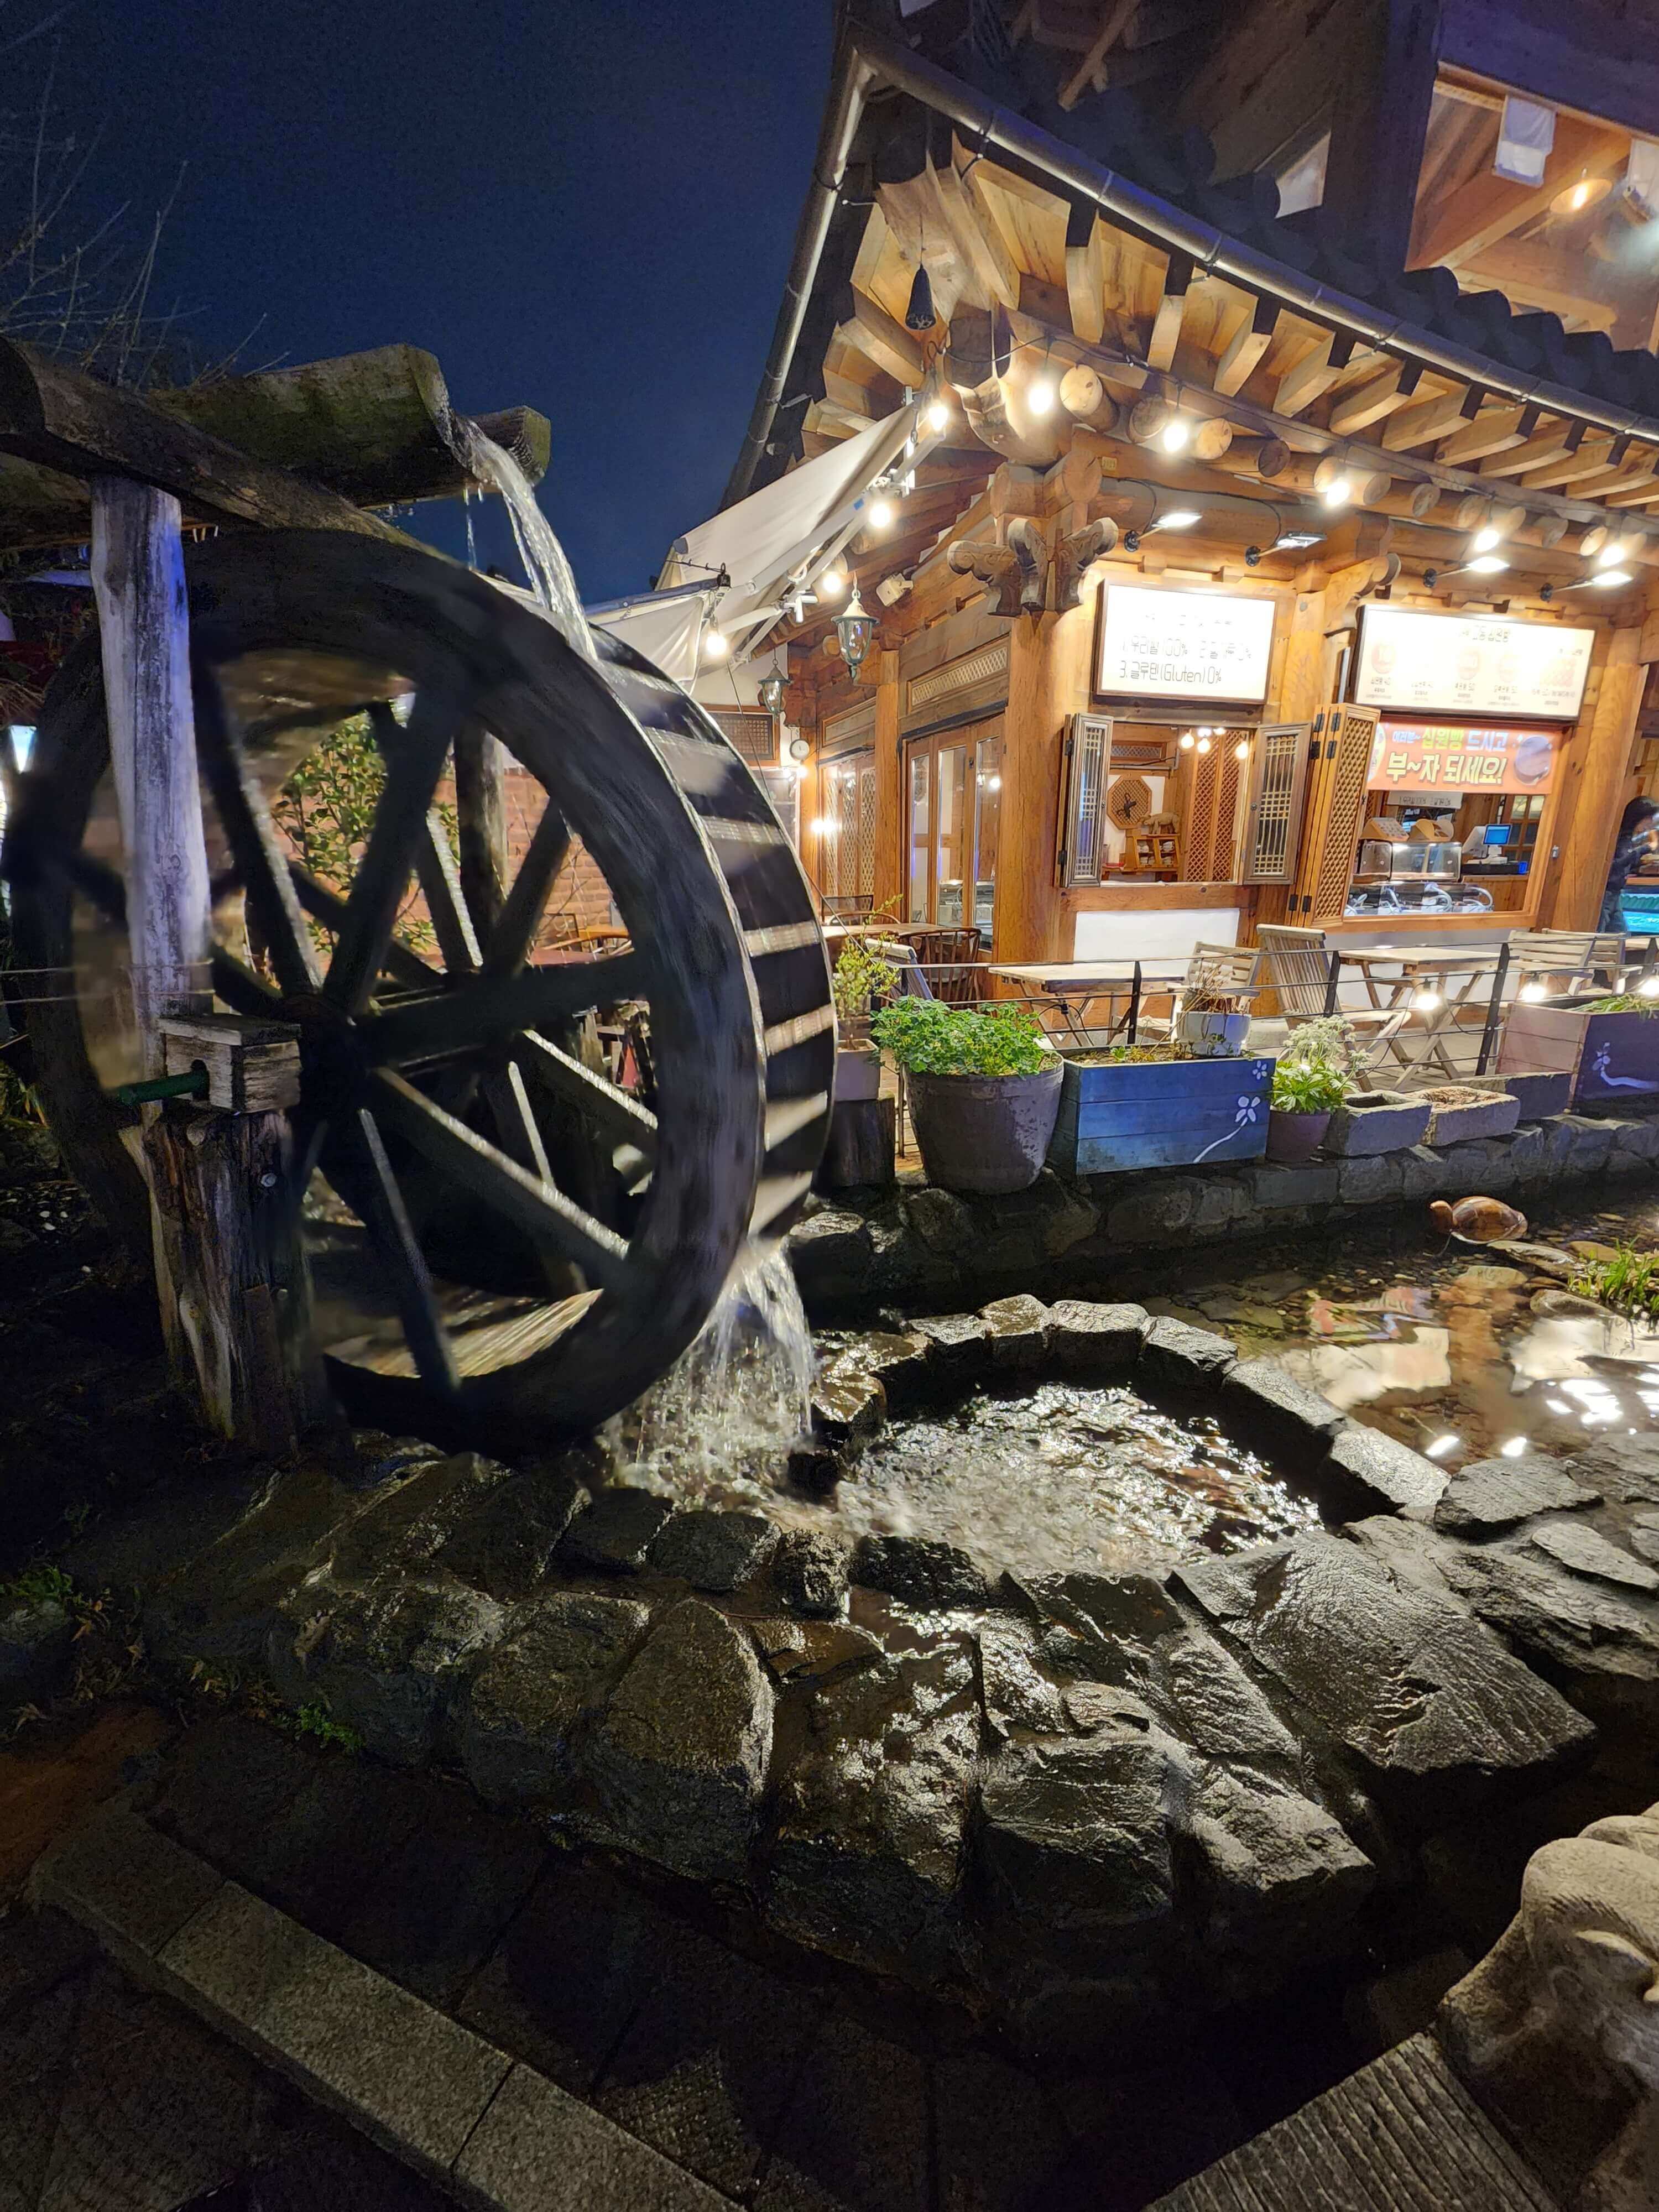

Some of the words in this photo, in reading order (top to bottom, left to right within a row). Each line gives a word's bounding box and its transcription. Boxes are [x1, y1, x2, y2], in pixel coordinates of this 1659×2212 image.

[1421, 727, 1465, 750] 십원빵
[1465, 729, 1509, 752] 드시고
[1386, 752, 1441, 784] 부~자
[1442, 754, 1509, 785] 되세요!
